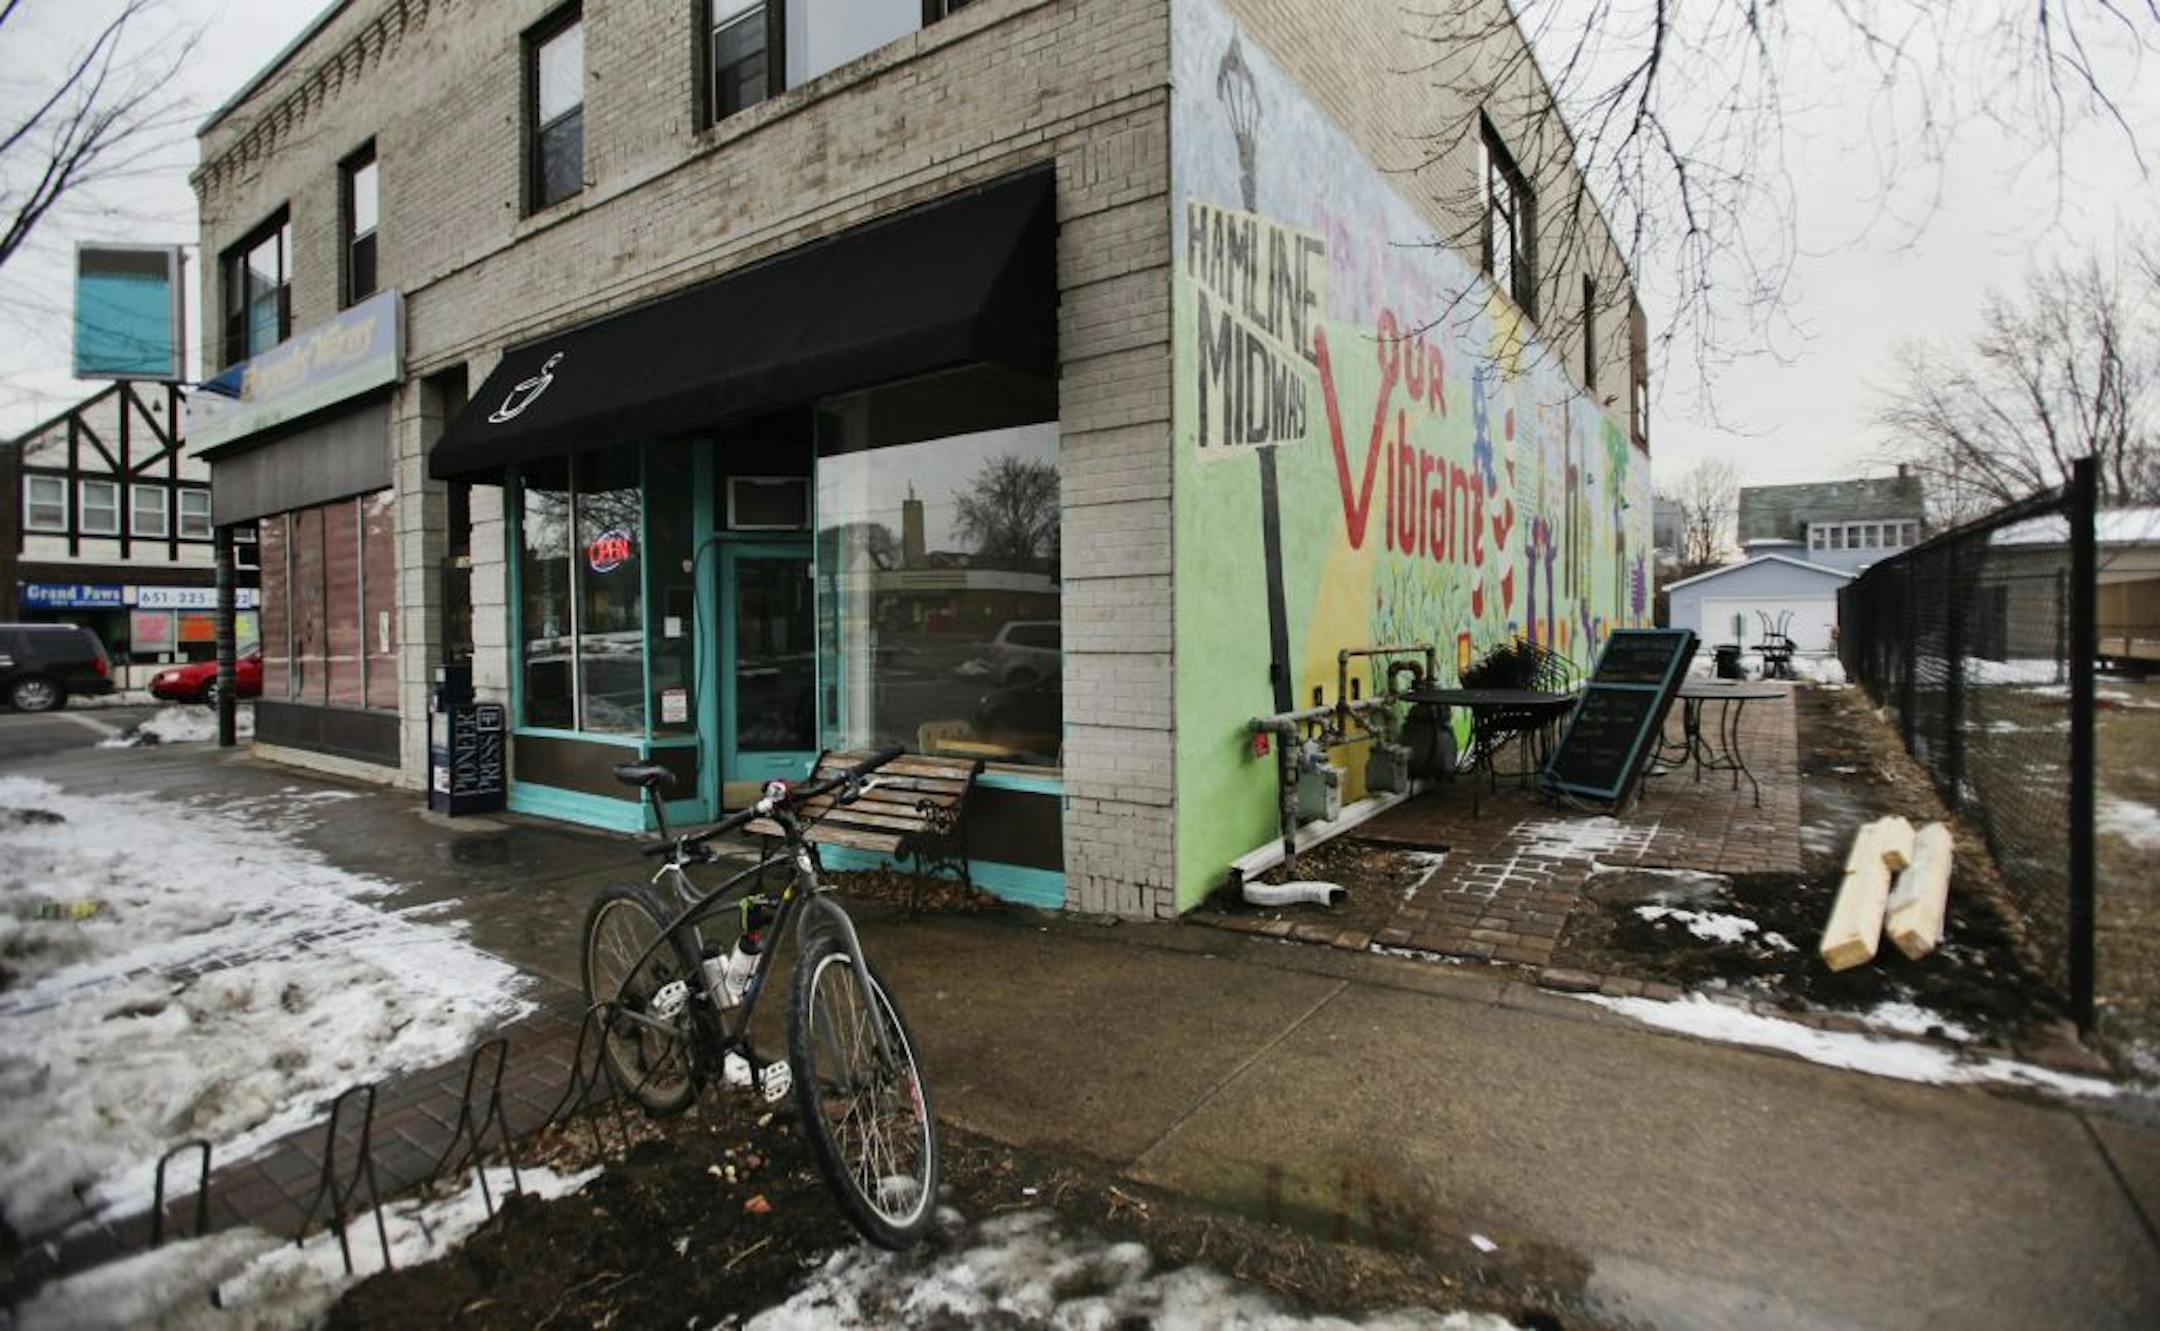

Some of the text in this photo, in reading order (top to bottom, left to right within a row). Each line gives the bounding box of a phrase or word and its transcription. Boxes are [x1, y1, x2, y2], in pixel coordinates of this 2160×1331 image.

[1187, 202, 1325, 368] HAMLINE
[1198, 287, 1306, 448] MIDWAY
[1377, 309, 1446, 419] OUR
[1314, 324, 1484, 568] Vibrant
[26, 584, 121, 601] Grand Paws
[589, 537, 630, 564] OPEN
[453, 710, 478, 798] PIONEER
[478, 733, 501, 795] PRESS
